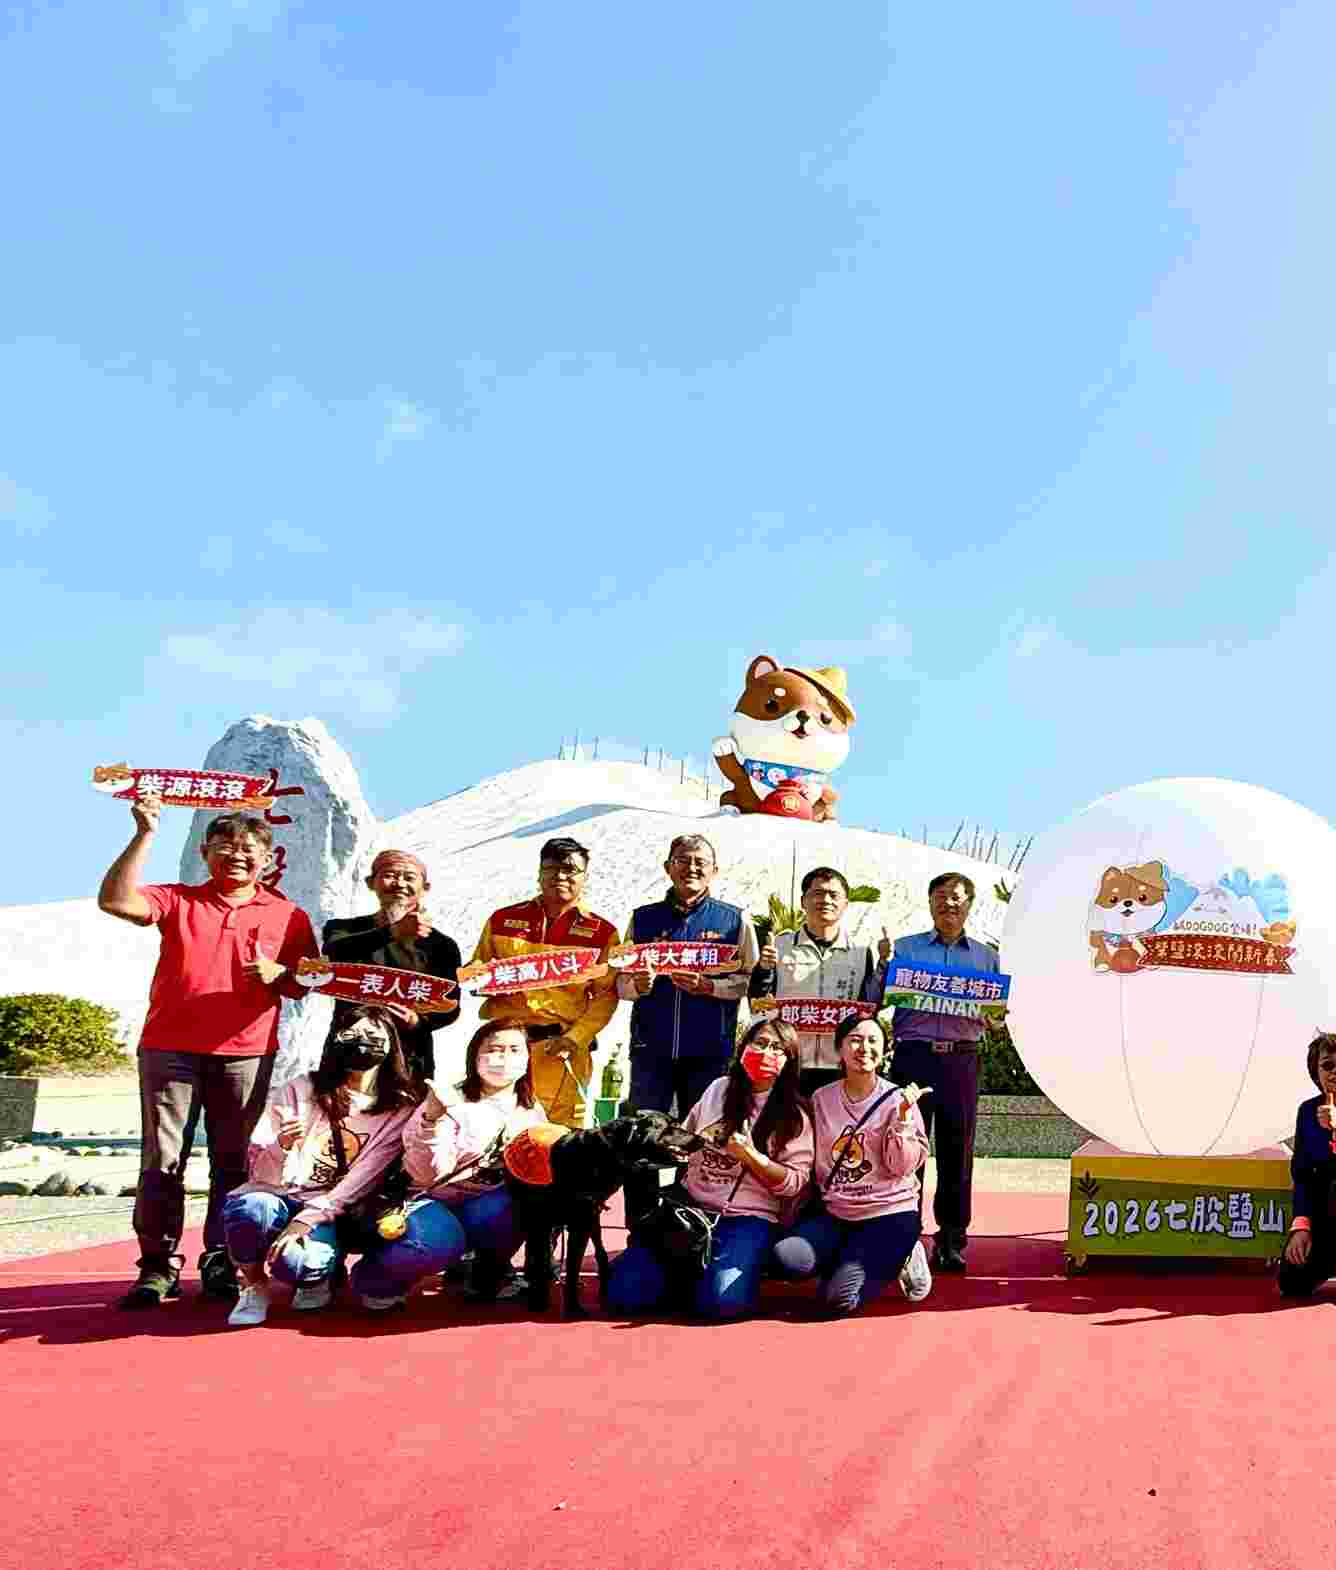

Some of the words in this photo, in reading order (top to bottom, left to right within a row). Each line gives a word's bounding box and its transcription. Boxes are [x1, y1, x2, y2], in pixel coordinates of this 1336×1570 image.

[137, 774, 246, 799] 柴源滾滾
[496, 950, 582, 984] 柴高八斗
[640, 947, 719, 967] 柴大氣粗
[336, 973, 432, 1000] 一表人柴
[895, 968, 1003, 999] 寵物友善城市
[912, 995, 982, 1018] TAINAN
[1083, 1192, 1284, 1239] 2026七股鹽山
